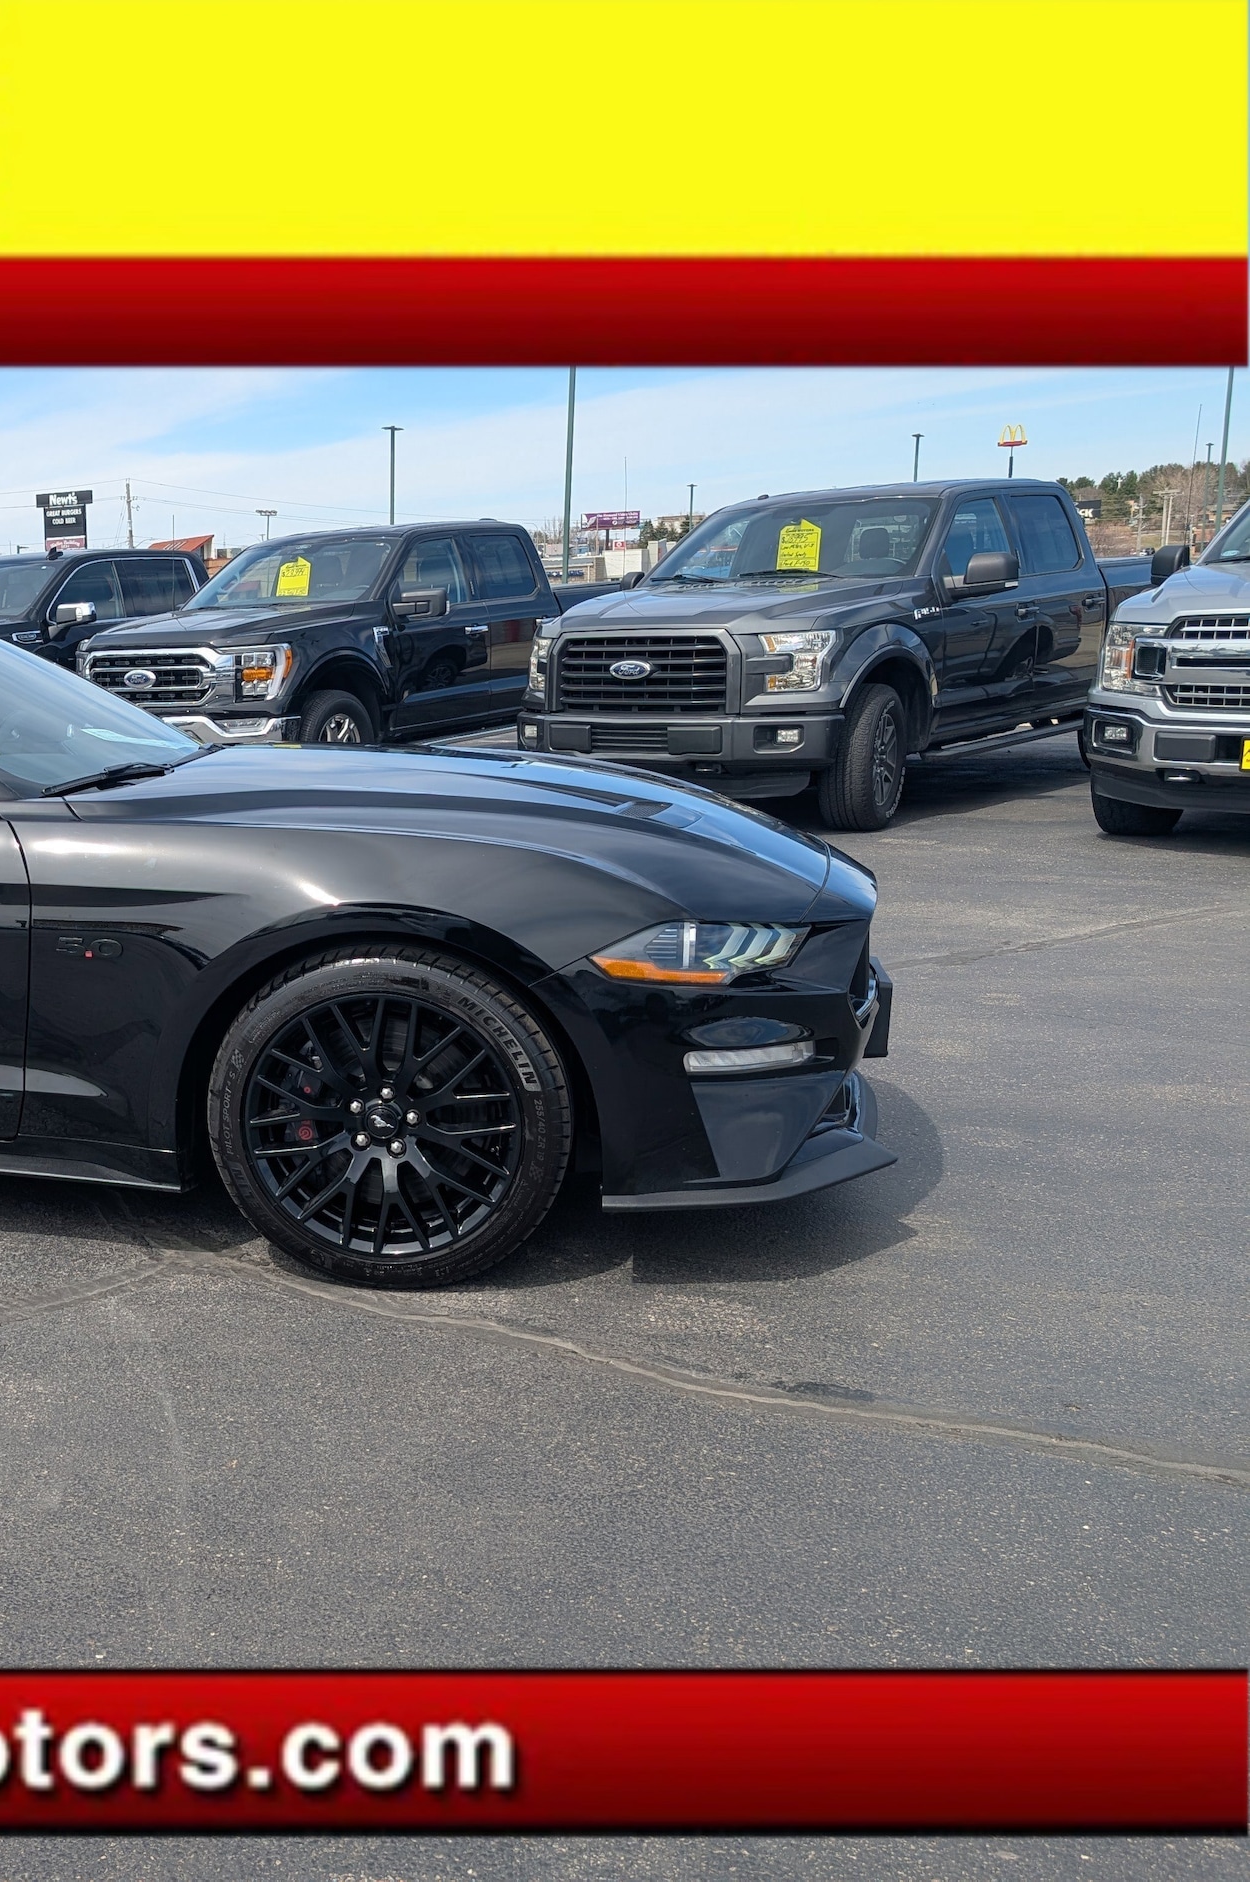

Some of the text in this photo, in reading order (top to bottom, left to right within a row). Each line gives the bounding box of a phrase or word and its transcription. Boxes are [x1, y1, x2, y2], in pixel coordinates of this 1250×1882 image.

[49, 492, 78, 506] Newt's
[61, 508, 82, 516] BURGERS
[618, 664, 640, 676] Ford
[56, 937, 124, 958] 5.0
[457, 996, 538, 1085] MICHELIN
[534, 1099, 547, 1134] 255/40
[223, 1124, 234, 1155] PILOT
